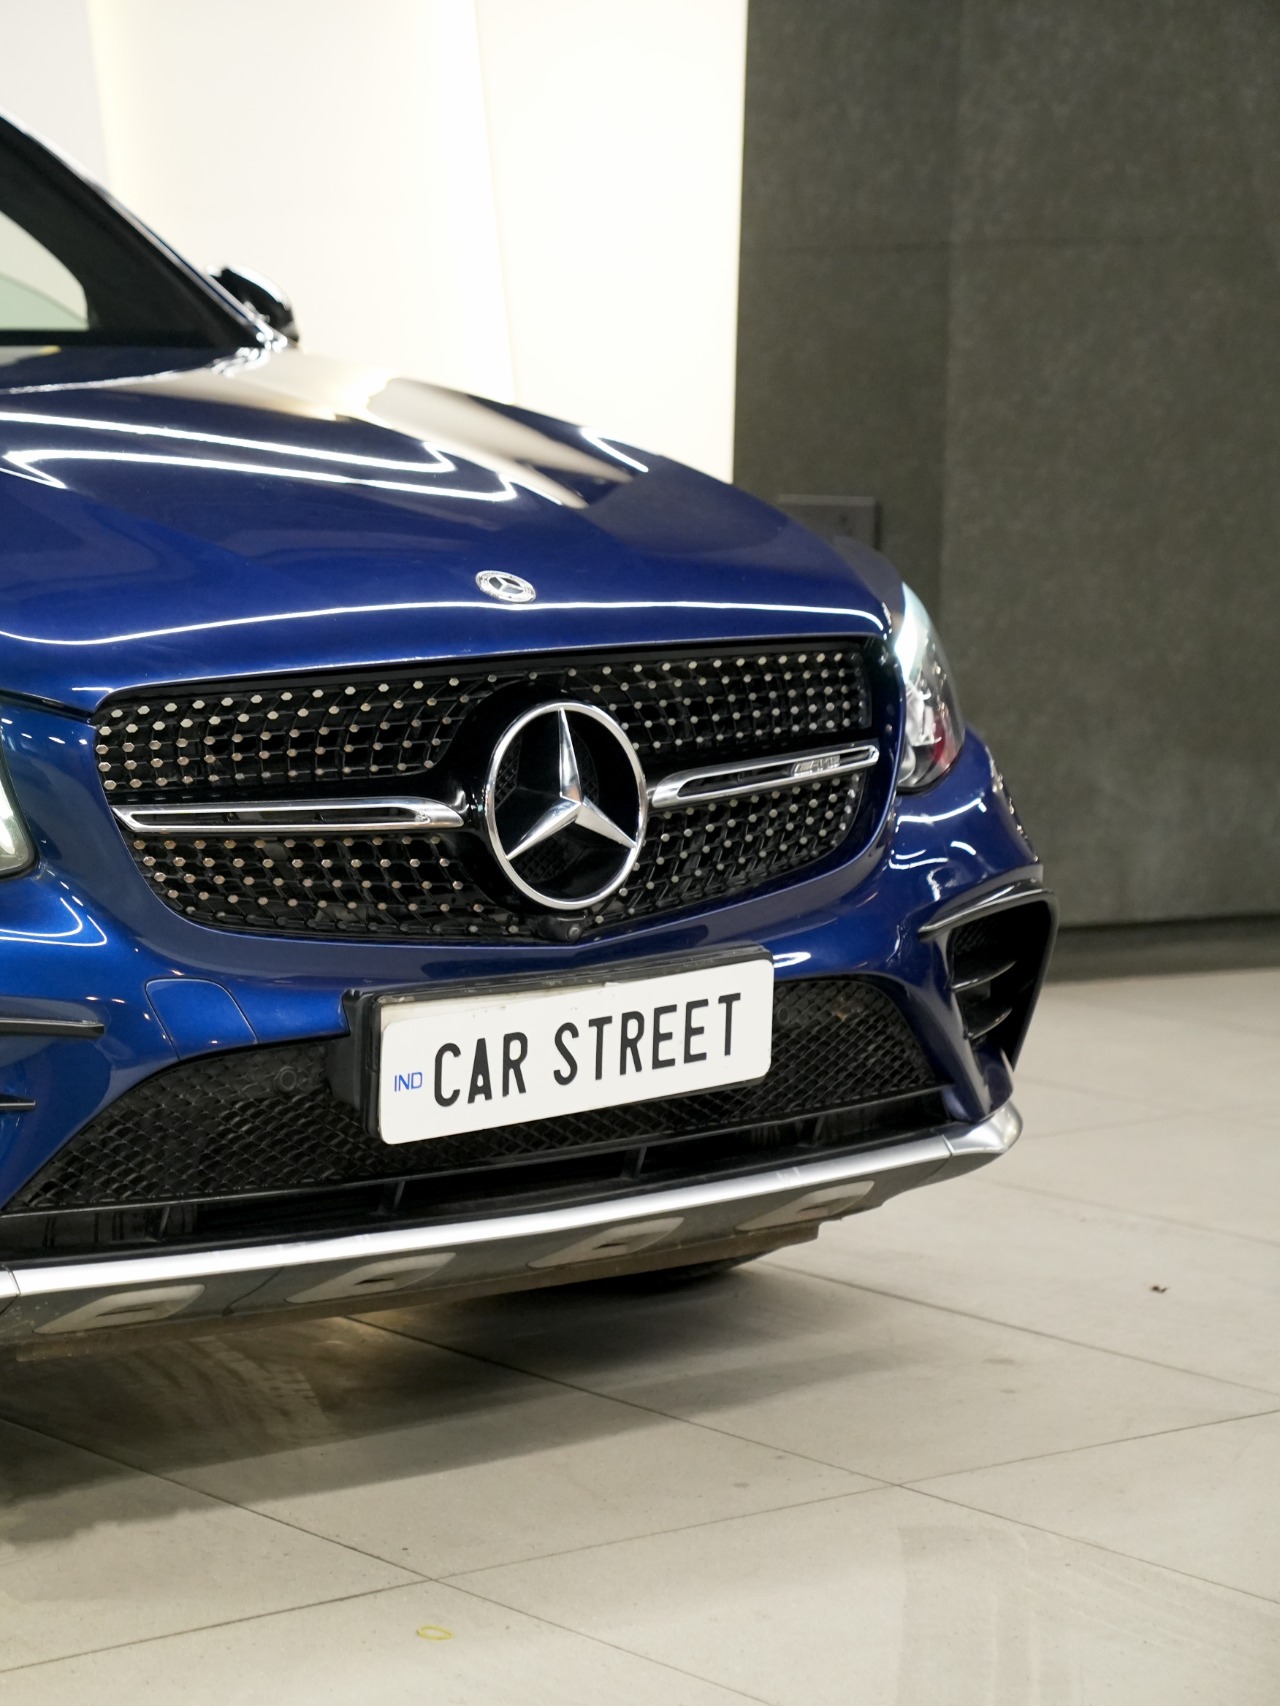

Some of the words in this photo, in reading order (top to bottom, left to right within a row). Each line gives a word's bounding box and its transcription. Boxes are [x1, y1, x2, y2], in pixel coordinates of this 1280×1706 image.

[394, 1071, 424, 1093] IND
[434, 1031, 528, 1107] CAR
[552, 992, 741, 1086] STREET
